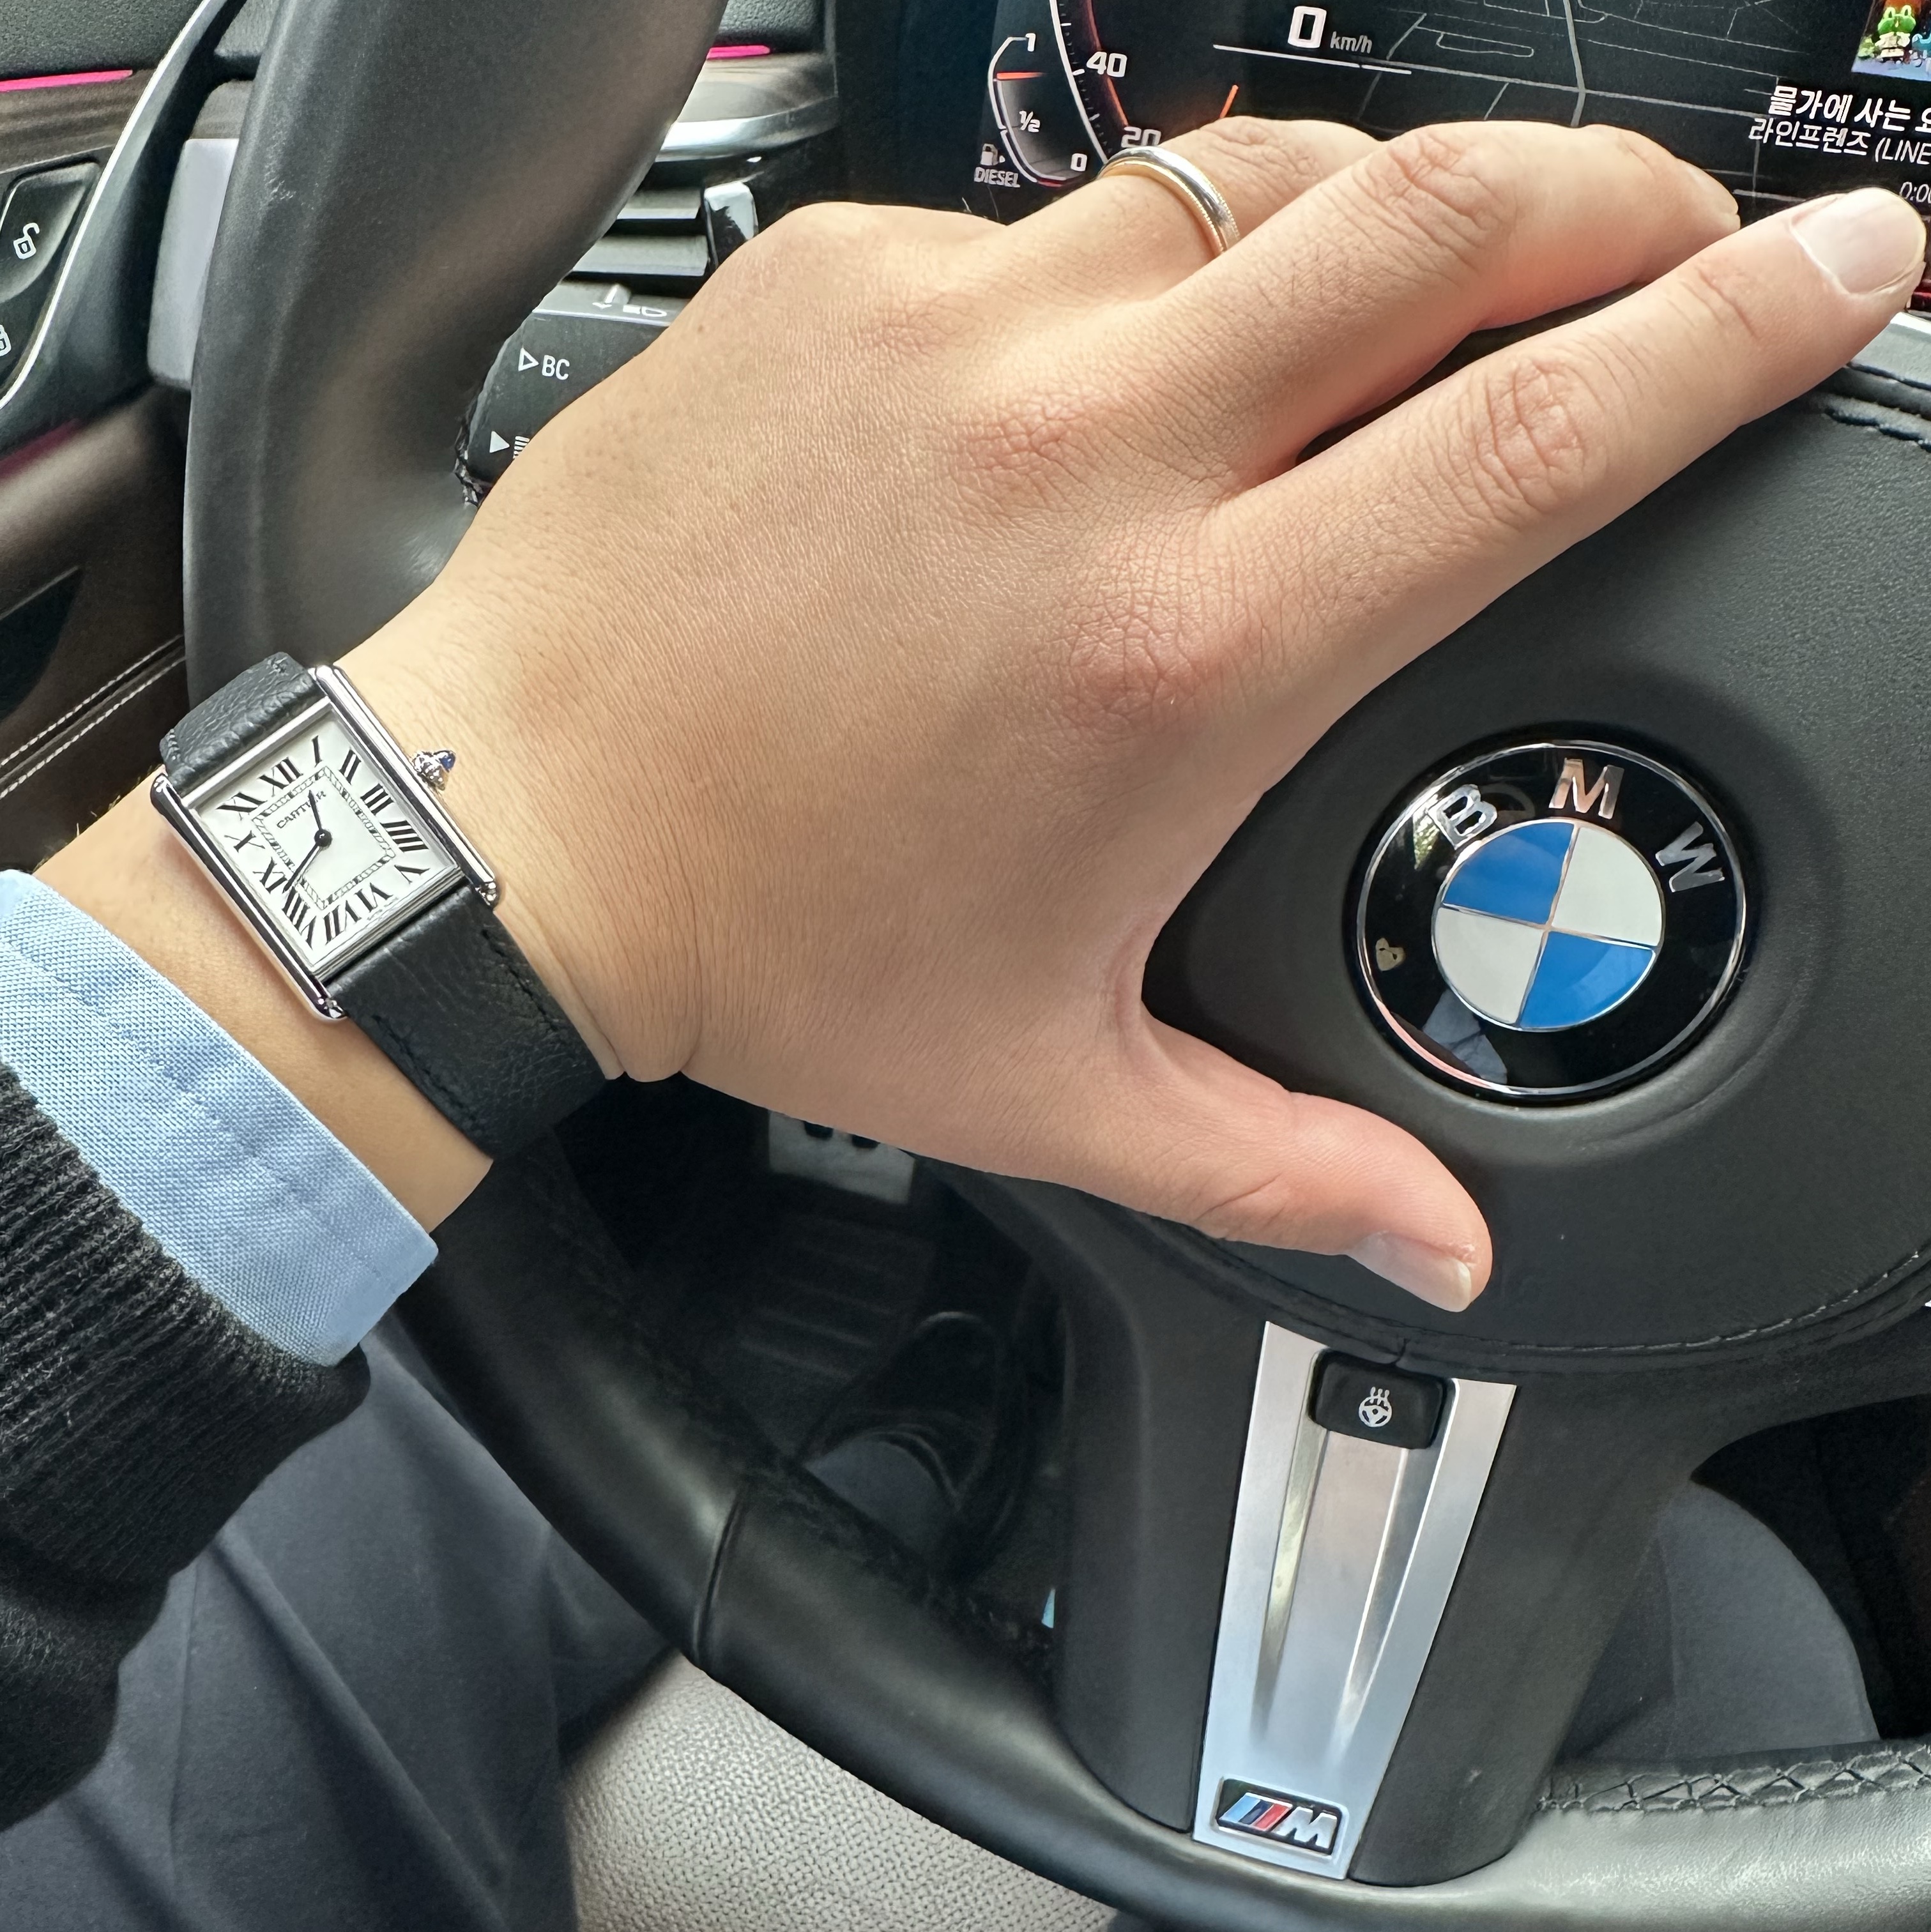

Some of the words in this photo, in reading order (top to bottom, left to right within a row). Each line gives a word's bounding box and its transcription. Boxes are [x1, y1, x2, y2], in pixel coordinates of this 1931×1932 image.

[1025, 33, 1036, 52] 1
[1288, 5, 1327, 49] 0
[1330, 31, 1372, 54] km/h
[1086, 51, 1127, 77] 40
[1854, 98, 1911, 132] 사는
[1121, 126, 1161, 148] 20
[1748, 117, 1872, 156] 라인프렌즈
[1875, 137, 1931, 165] (LINE
[1070, 153, 1087, 172] 0
[973, 167, 1021, 188] DIESEL
[541, 354, 570, 380] BC
[258, 757, 304, 797] XII
[1428, 757, 1725, 894] BMW
